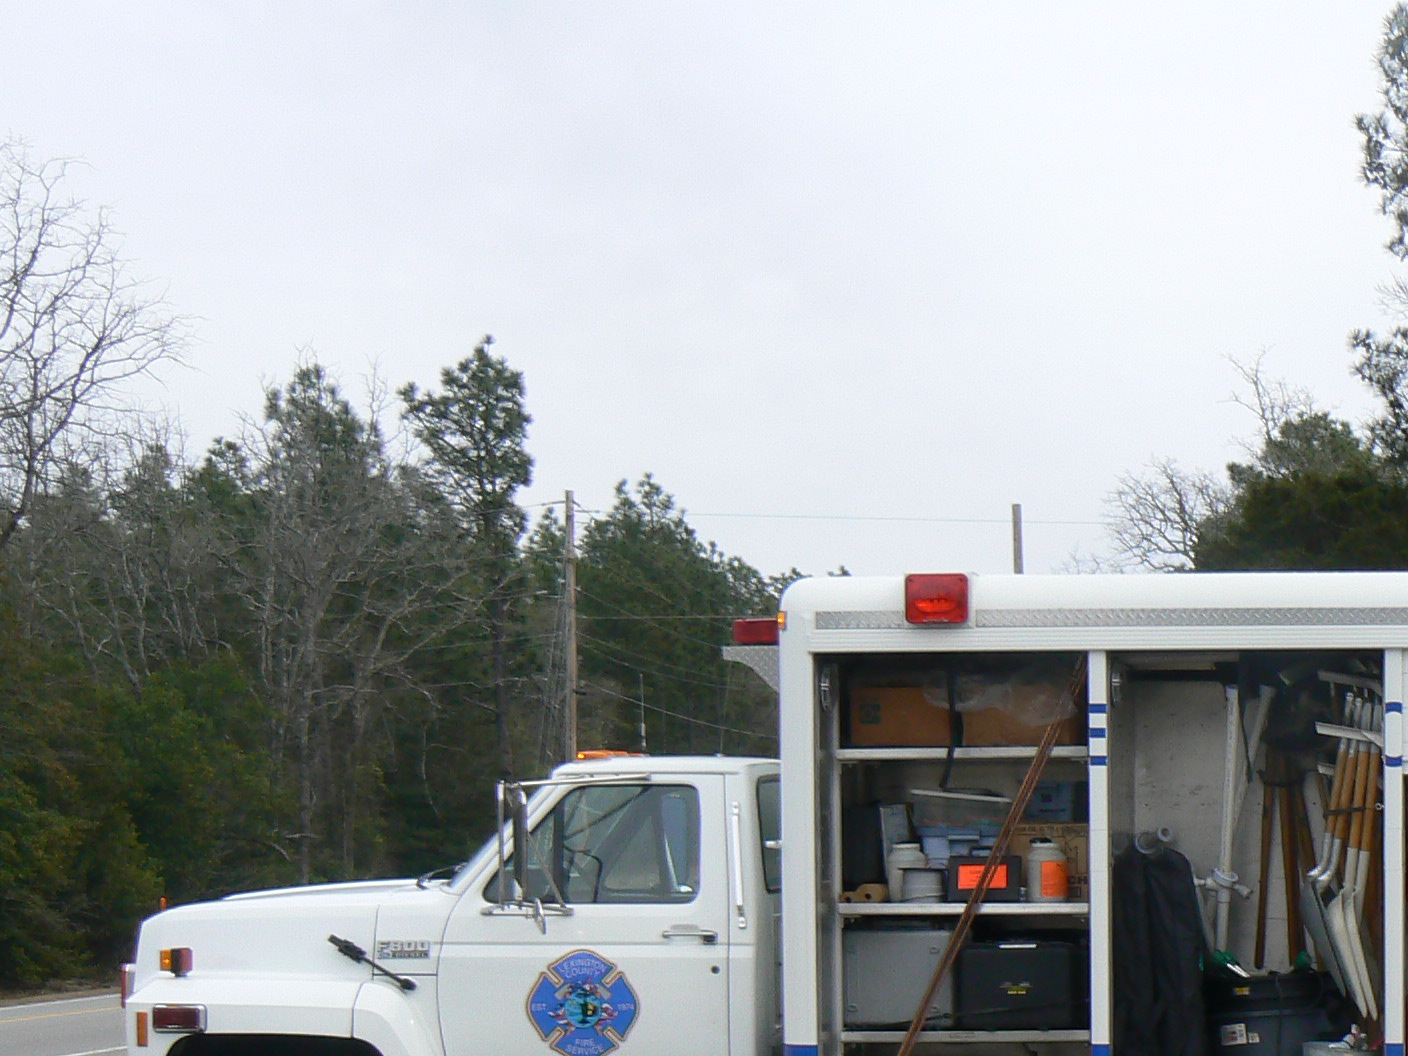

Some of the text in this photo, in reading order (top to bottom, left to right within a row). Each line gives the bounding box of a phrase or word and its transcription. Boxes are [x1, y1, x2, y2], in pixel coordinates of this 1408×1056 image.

[557, 958, 608, 973] LEXINGTON
[564, 967, 601, 979] COUNTY
[574, 1038, 595, 1047] FIRE
[564, 1044, 605, 1056] SERVICE
